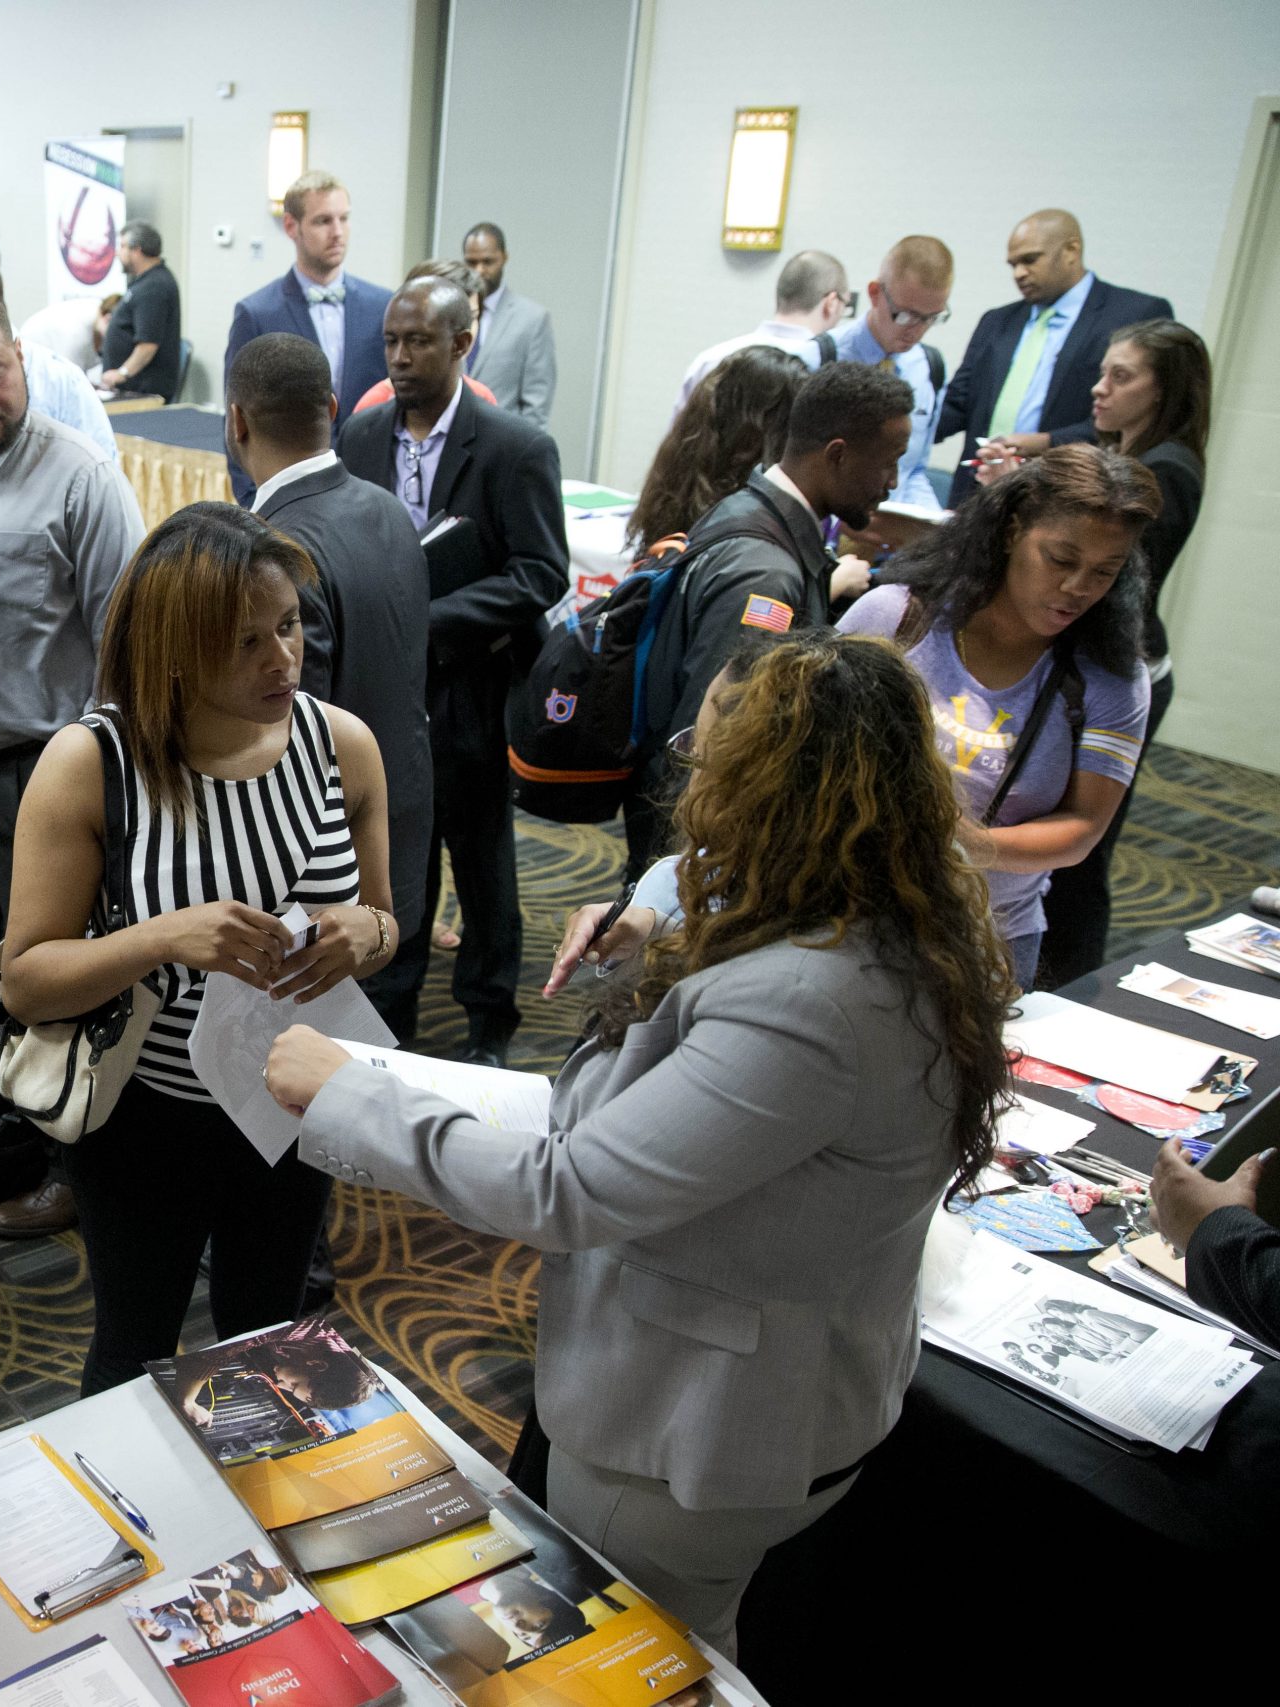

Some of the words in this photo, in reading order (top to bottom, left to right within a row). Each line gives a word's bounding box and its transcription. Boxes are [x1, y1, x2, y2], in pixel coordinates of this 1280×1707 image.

[376, 1438, 408, 1454] Networking
[332, 1453, 365, 1470] Information
[384, 1450, 421, 1471] University
[403, 1456, 427, 1472] DeVry
[308, 1464, 333, 1478] Security
[424, 1486, 436, 1495] and
[436, 1480, 450, 1490] Web
[391, 1490, 425, 1508] Multimedia
[425, 1495, 464, 1516] University
[359, 1509, 371, 1518] and
[370, 1502, 392, 1515] Design
[444, 1501, 470, 1517] DeVry
[320, 1513, 359, 1530] Development
[541, 1642, 556, 1653] That
[623, 1635, 658, 1657] Information
[522, 1652, 534, 1661] You
[597, 1652, 624, 1671] Systems
[637, 1652, 678, 1677] University
[659, 1660, 687, 1677] DeVry
[241, 1667, 293, 1692] University
[265, 1677, 300, 1697] DeVry
